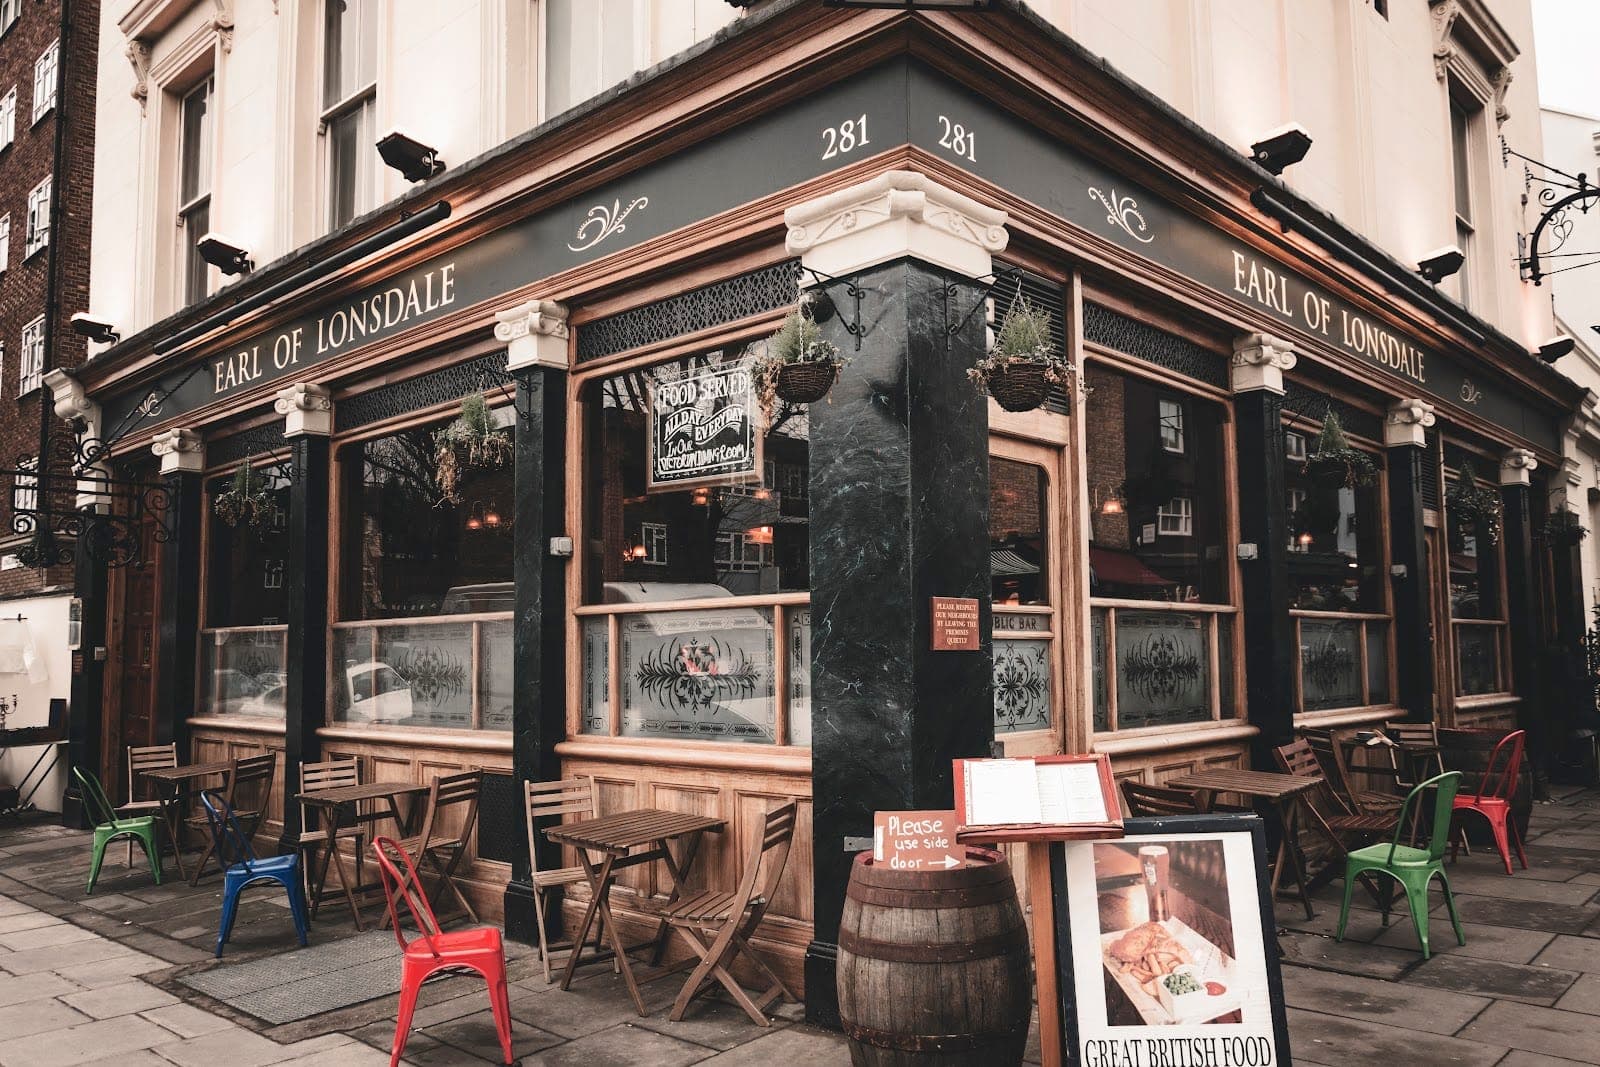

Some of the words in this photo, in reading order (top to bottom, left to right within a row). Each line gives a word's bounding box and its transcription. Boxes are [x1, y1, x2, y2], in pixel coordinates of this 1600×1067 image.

[821, 113, 870, 161] 281
[938, 115, 977, 163] 281
[214, 345, 263, 395] EARL
[273, 328, 303, 370] OF
[316, 262, 456, 355] LONSDALE
[1232, 250, 1293, 318] EARL
[1303, 291, 1331, 336] OF
[1341, 309, 1426, 384] LONSDALE
[660, 383, 697, 407] FOOD
[700, 373, 747, 400] SERVED
[1018, 616, 1037, 630] BAR
[946, 637, 968, 645] QUIETLY
[894, 839, 918, 850] use
[922, 836, 949, 850] side
[890, 850, 924, 870] door
[1084, 1039, 1142, 1067] GREAT
[1145, 1037, 1216, 1067] BRITISH
[1221, 1036, 1272, 1067] FOOD
